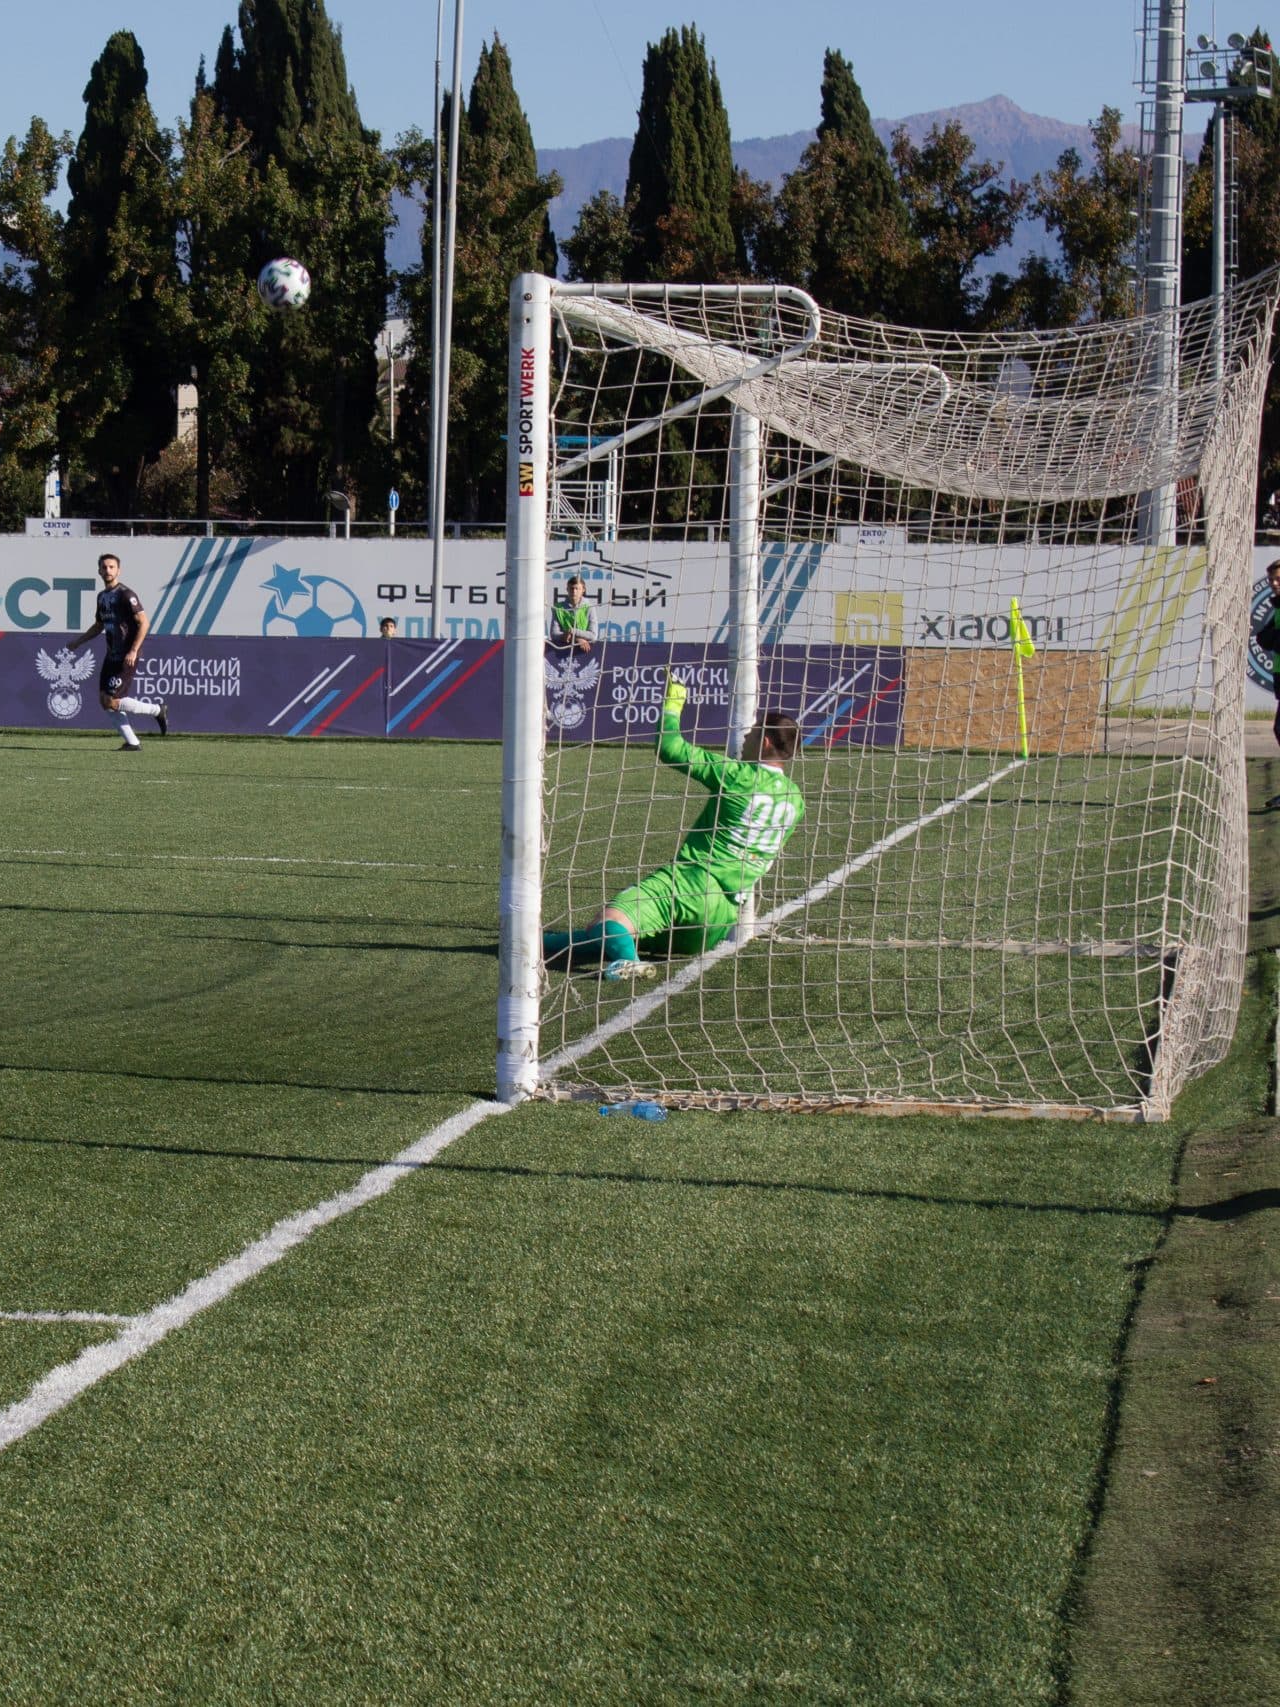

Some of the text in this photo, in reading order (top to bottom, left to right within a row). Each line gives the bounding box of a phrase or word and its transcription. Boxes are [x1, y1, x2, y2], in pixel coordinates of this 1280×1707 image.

[519, 347, 535, 454] SPORTWERK
[519, 462, 533, 496] SW
[135, 656, 241, 677] ССИЙСКИЙ
[133, 676, 241, 697] ТБОЛЬНЫЙ
[611, 705, 661, 724] СОЮ
